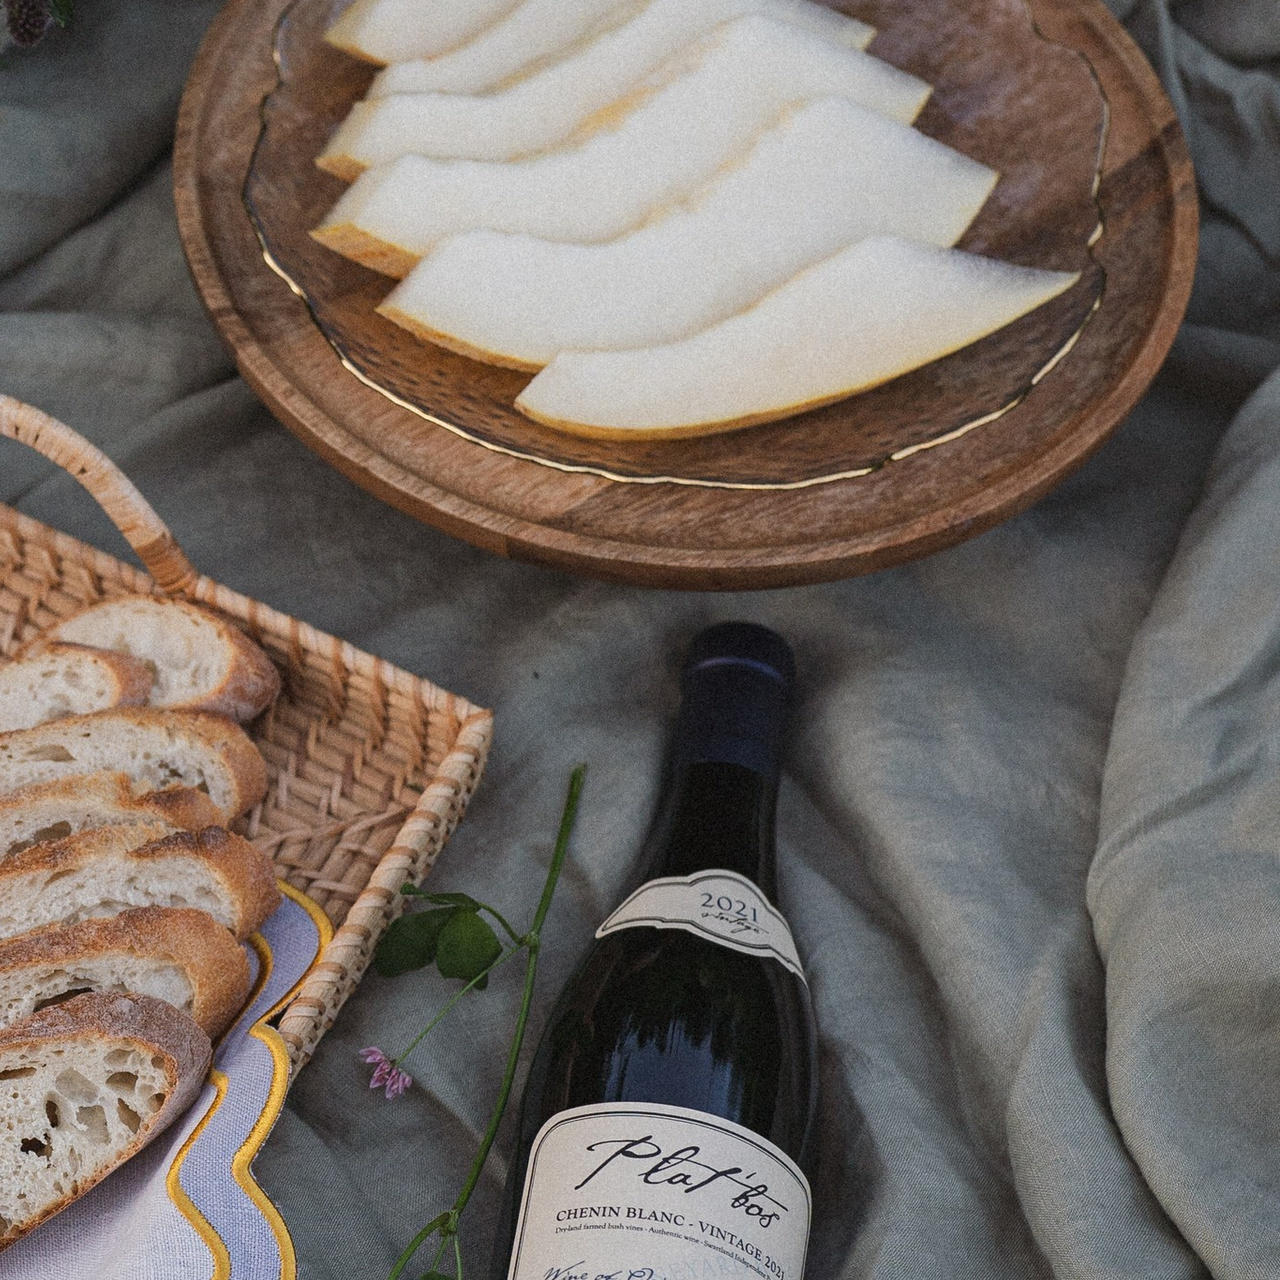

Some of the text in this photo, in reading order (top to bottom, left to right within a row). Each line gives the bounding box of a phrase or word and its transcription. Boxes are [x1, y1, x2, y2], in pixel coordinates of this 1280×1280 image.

[701, 892, 757, 923] 2021
[556, 1206, 621, 1222] CHENIN
[626, 1207, 685, 1227] BLANC
[698, 1220, 763, 1262] VINTAGE
[583, 1222, 606, 1231] farmed
[607, 1223, 625, 1231] bush
[626, 1224, 643, 1232] vines
[648, 1226, 682, 1239] Authentic
[683, 1233, 700, 1244] wine
[704, 1239, 735, 1259] Swartland
